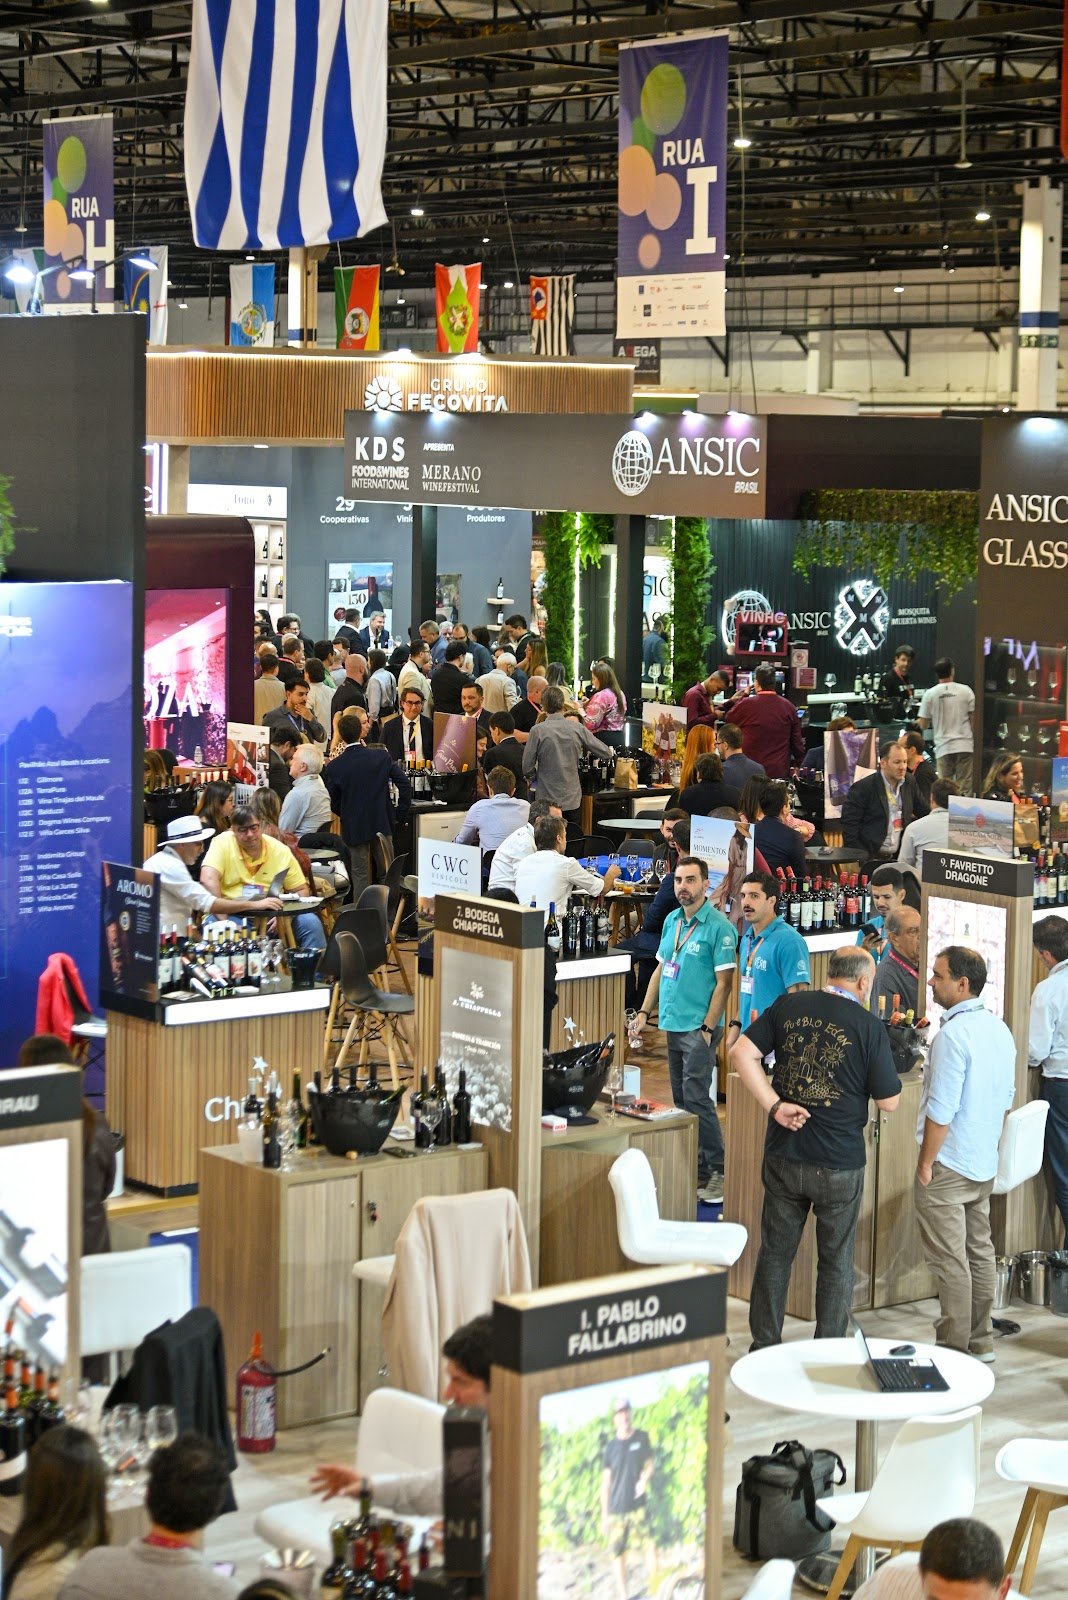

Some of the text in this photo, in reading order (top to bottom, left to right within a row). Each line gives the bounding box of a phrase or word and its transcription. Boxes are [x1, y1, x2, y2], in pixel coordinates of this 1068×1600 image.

[662, 137, 706, 167] RUA
[71, 196, 99, 218] RUA
[685, 165, 718, 255] I
[86, 219, 115, 289] H
[430, 378, 488, 393] GRUPO
[407, 393, 509, 412] FECOVITA
[652, 436, 760, 478] ANSIC
[422, 464, 482, 481] MERANO
[351, 478, 409, 490] INTERNATIONAL
[422, 481, 480, 494] WINEFESTIVAL
[734, 481, 760, 495] BRASIL
[985, 492, 1068, 524] ANSIC
[319, 514, 370, 525] Cooperativas
[466, 513, 506, 523] Produtores
[982, 538, 1068, 569] GLASS
[431, 853, 469, 876] CWC
[949, 858, 994, 876] FAVRETTO
[945, 869, 988, 886] DRAGONE
[116, 879, 153, 898] AROMO
[464, 907, 500, 925] BODEGA
[452, 918, 504, 938] CHIAPPELLA
[0, 1094, 40, 1116] RAU
[597, 1295, 660, 1327] PABLO
[568, 1312, 687, 1357] FALLABRINO
